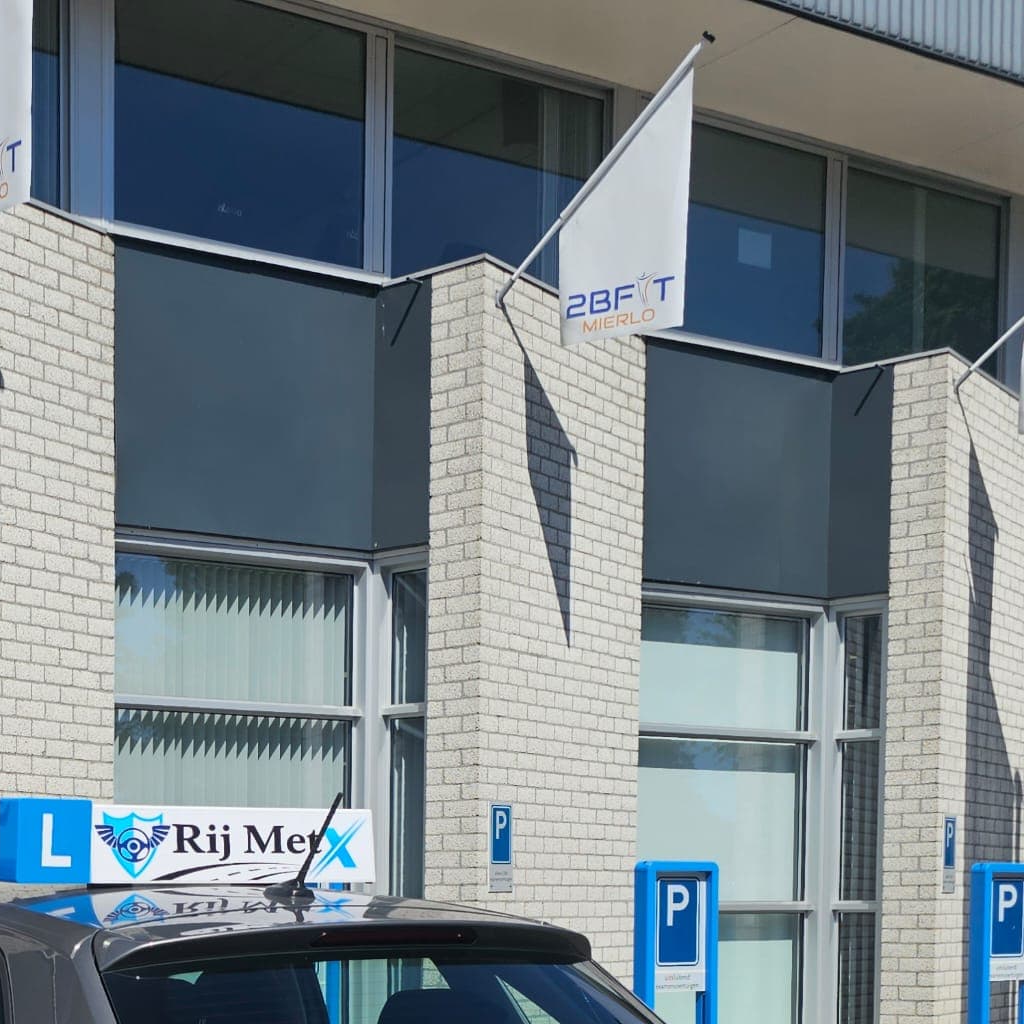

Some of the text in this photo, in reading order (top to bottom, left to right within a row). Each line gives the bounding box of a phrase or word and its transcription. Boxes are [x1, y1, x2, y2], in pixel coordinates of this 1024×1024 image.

[582, 308, 655, 333] MIERLO
[41, 812, 72, 868] L
[172, 823, 231, 861] Rij
[243, 824, 323, 855] Met
[495, 810, 507, 840] P
[946, 822, 954, 849] P
[666, 884, 690, 927] P
[998, 884, 1018, 923] P
